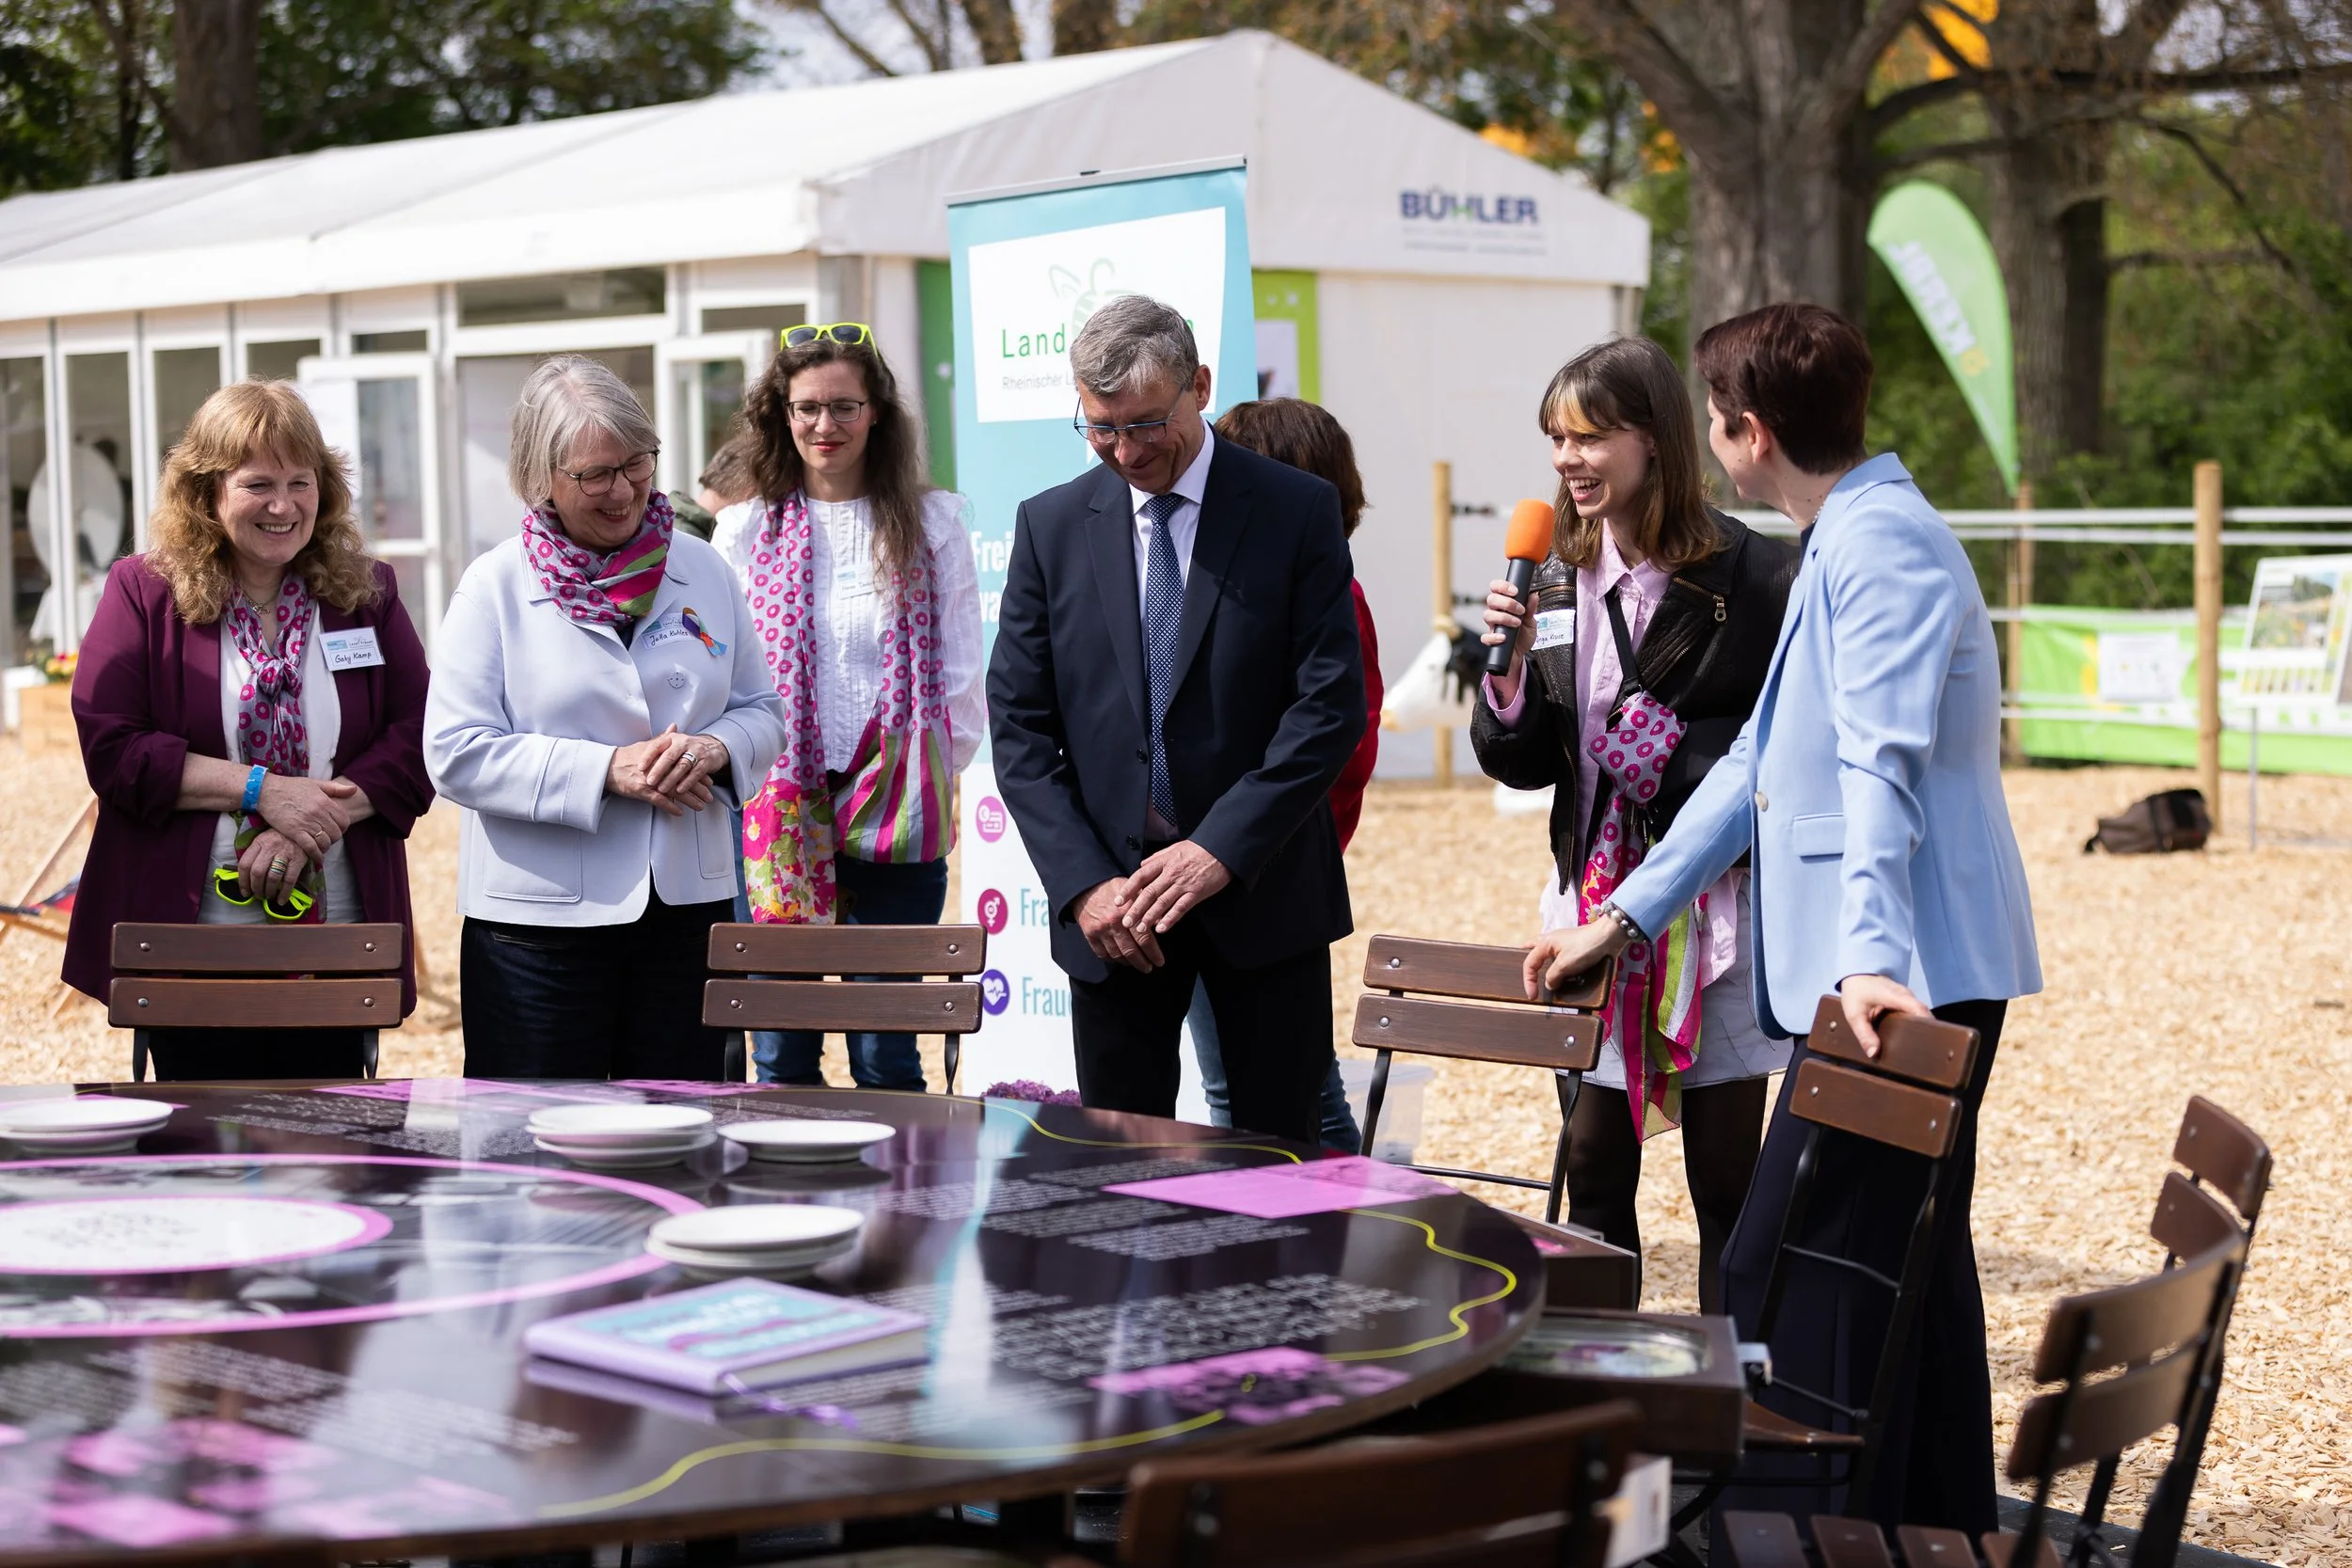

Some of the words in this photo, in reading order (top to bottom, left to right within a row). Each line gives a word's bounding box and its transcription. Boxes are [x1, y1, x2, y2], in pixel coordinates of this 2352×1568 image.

[1400, 186, 1539, 224] BÜHLER
[1002, 373, 1063, 389] Rheinischer
[650, 634, 668, 646] Jutta
[335, 654, 352, 664] Gaby
[353, 652, 372, 660] Kamp
[1022, 976, 1072, 1017] Frau
